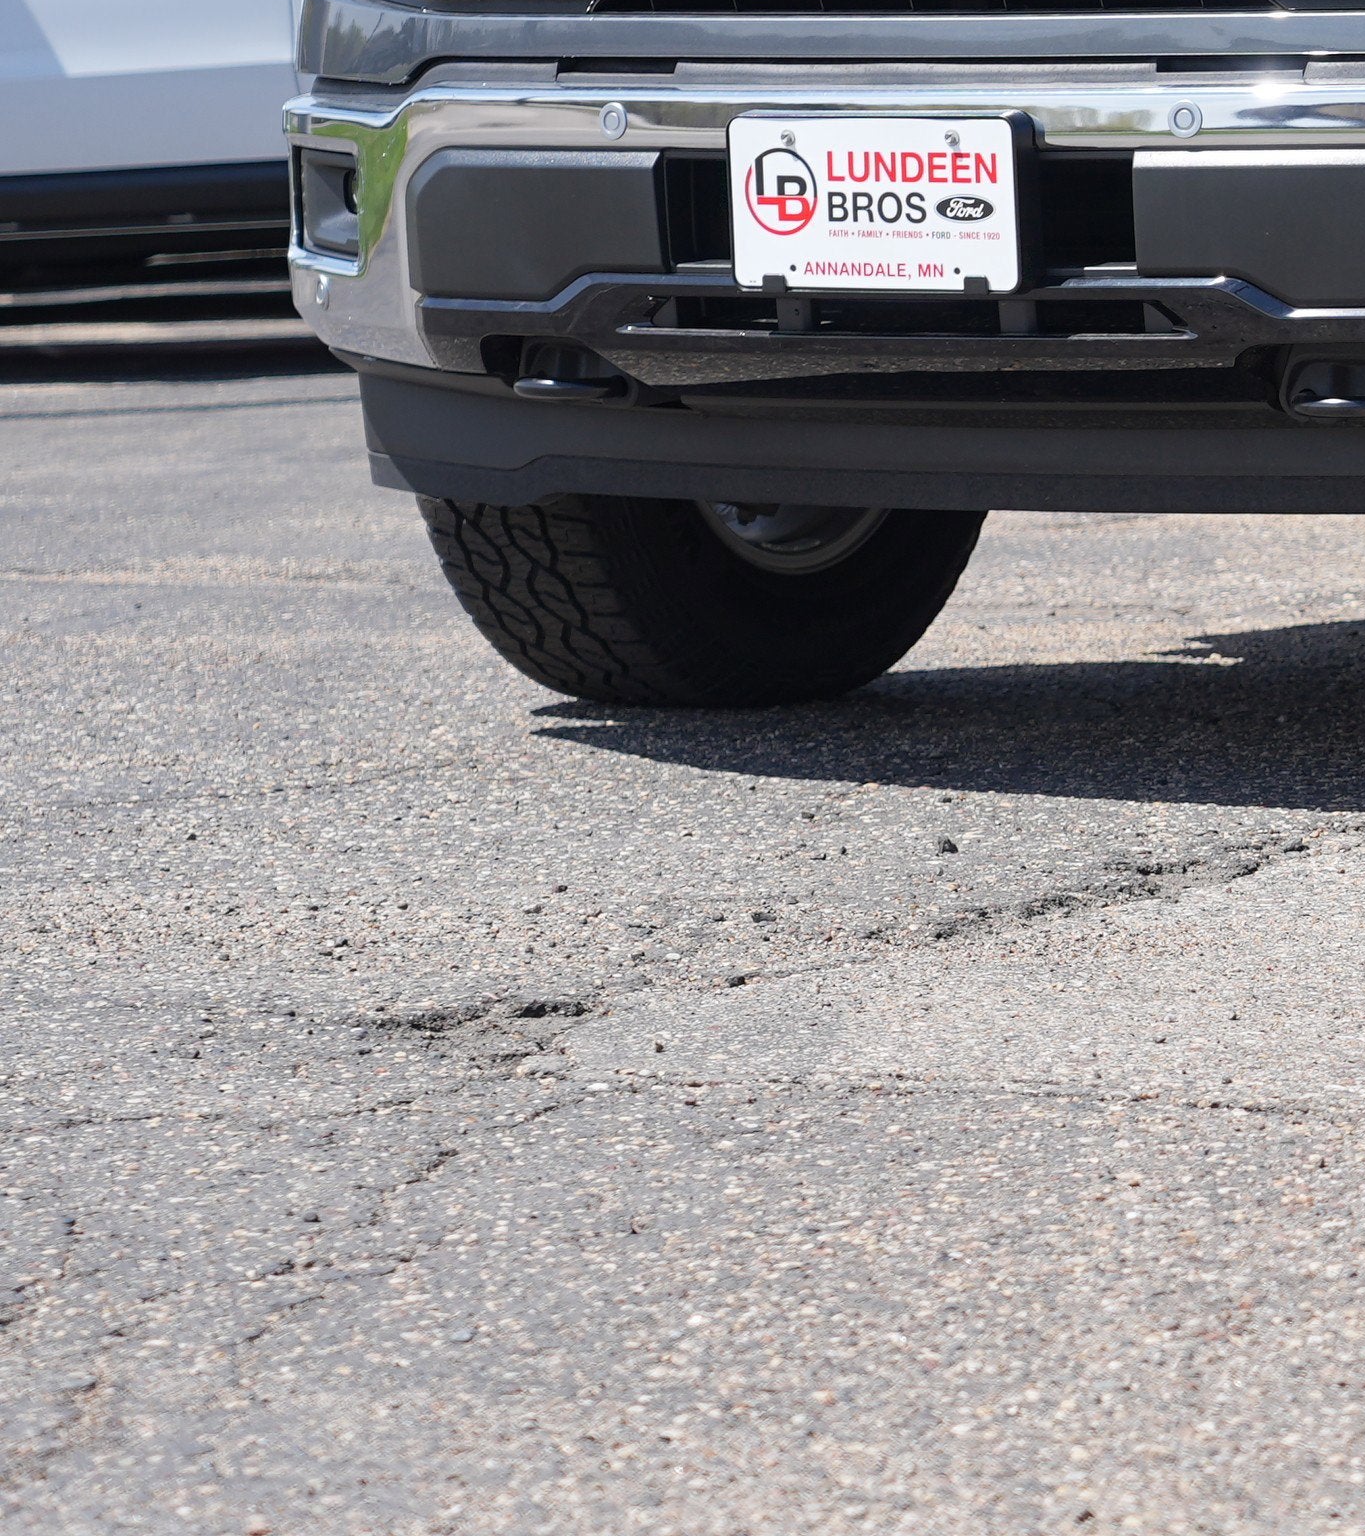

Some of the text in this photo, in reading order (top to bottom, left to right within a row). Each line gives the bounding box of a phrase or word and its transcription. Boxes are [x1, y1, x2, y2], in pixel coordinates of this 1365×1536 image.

[826, 151, 998, 184] LUNDEEN
[828, 191, 928, 224] BROS
[946, 197, 985, 218] Ford
[828, 229, 1001, 240] FAITH FAMILY FRIENDS FORD SINCE 1920
[803, 261, 944, 280] ANNANDALE, MN
